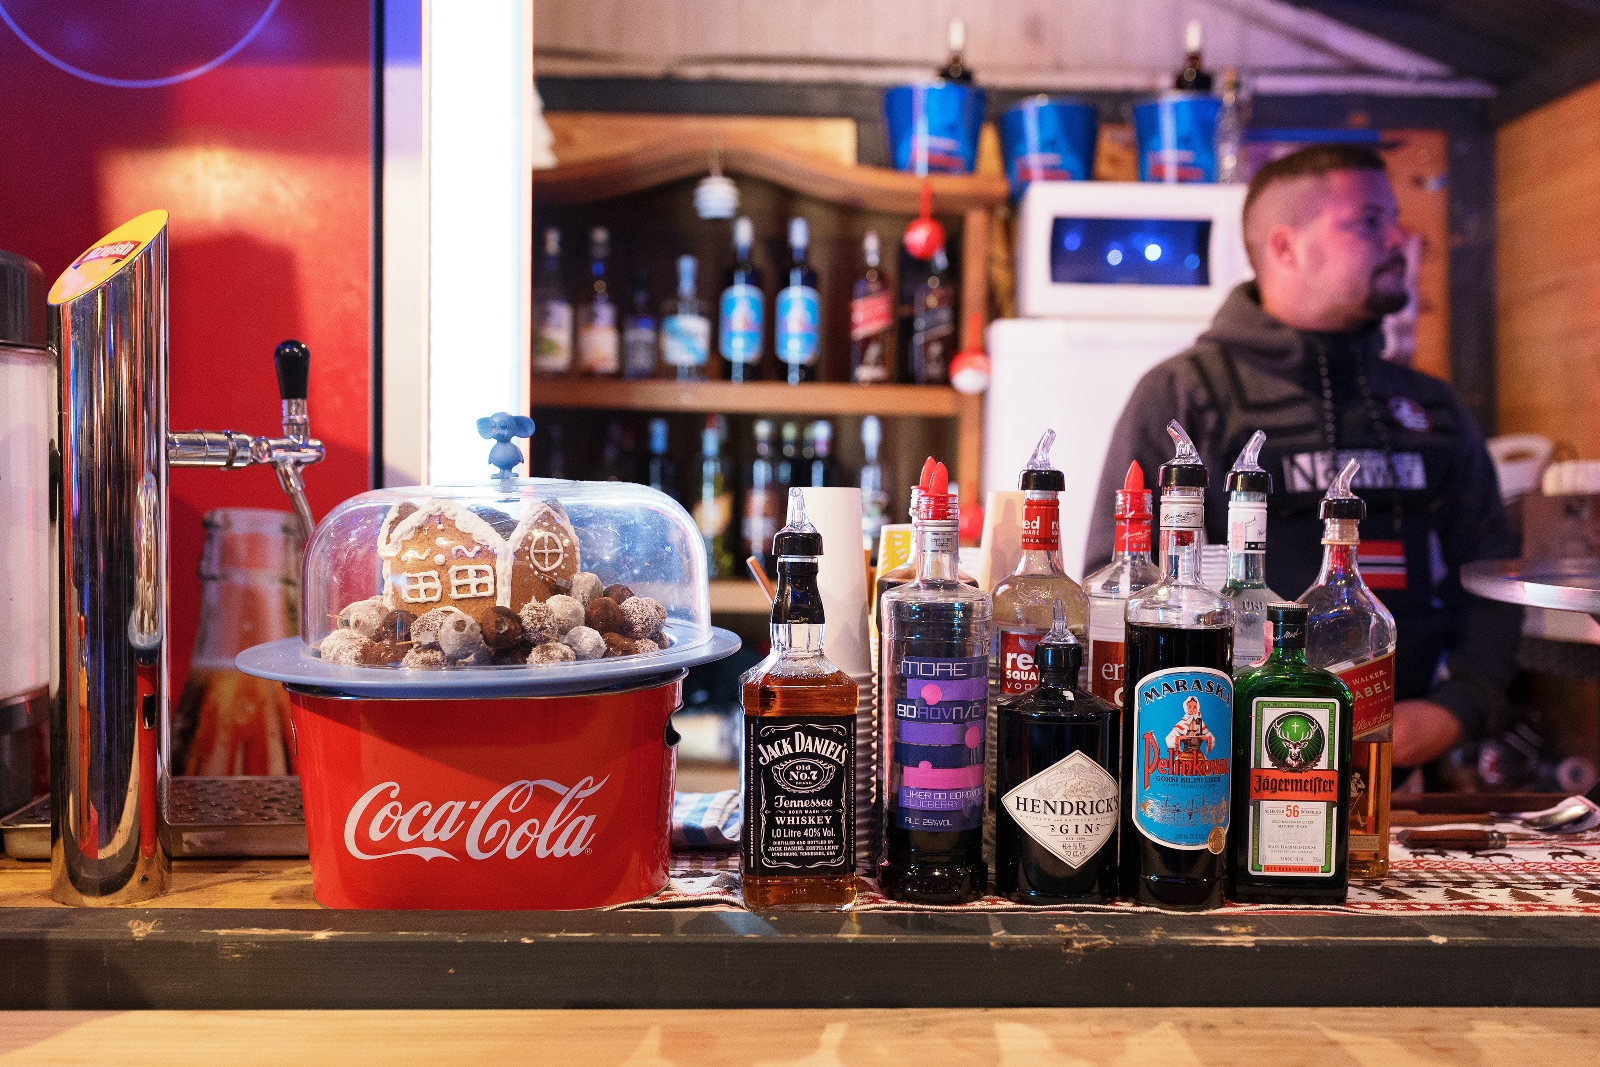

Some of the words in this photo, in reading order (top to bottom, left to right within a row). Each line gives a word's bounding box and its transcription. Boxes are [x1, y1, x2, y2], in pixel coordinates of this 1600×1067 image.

[1022, 515, 1041, 530] ed
[901, 660, 968, 676] MORE
[1006, 652, 1038, 670] re
[1006, 670, 1040, 681] SQUA
[1354, 680, 1391, 702] ABEL
[757, 737, 795, 766] JACK
[794, 731, 849, 765] DANIEL'S
[789, 771, 818, 781] No.7
[774, 795, 833, 808] Tennessee
[344, 773, 612, 862] Coca-Cola
[1285, 804, 1300, 818] 56
[775, 815, 833, 825] WHISKEY
[783, 828, 802, 838] Litre
[803, 828, 821, 838] 40%
[822, 827, 836, 837] Vol.
[1059, 823, 1094, 834] GIN
